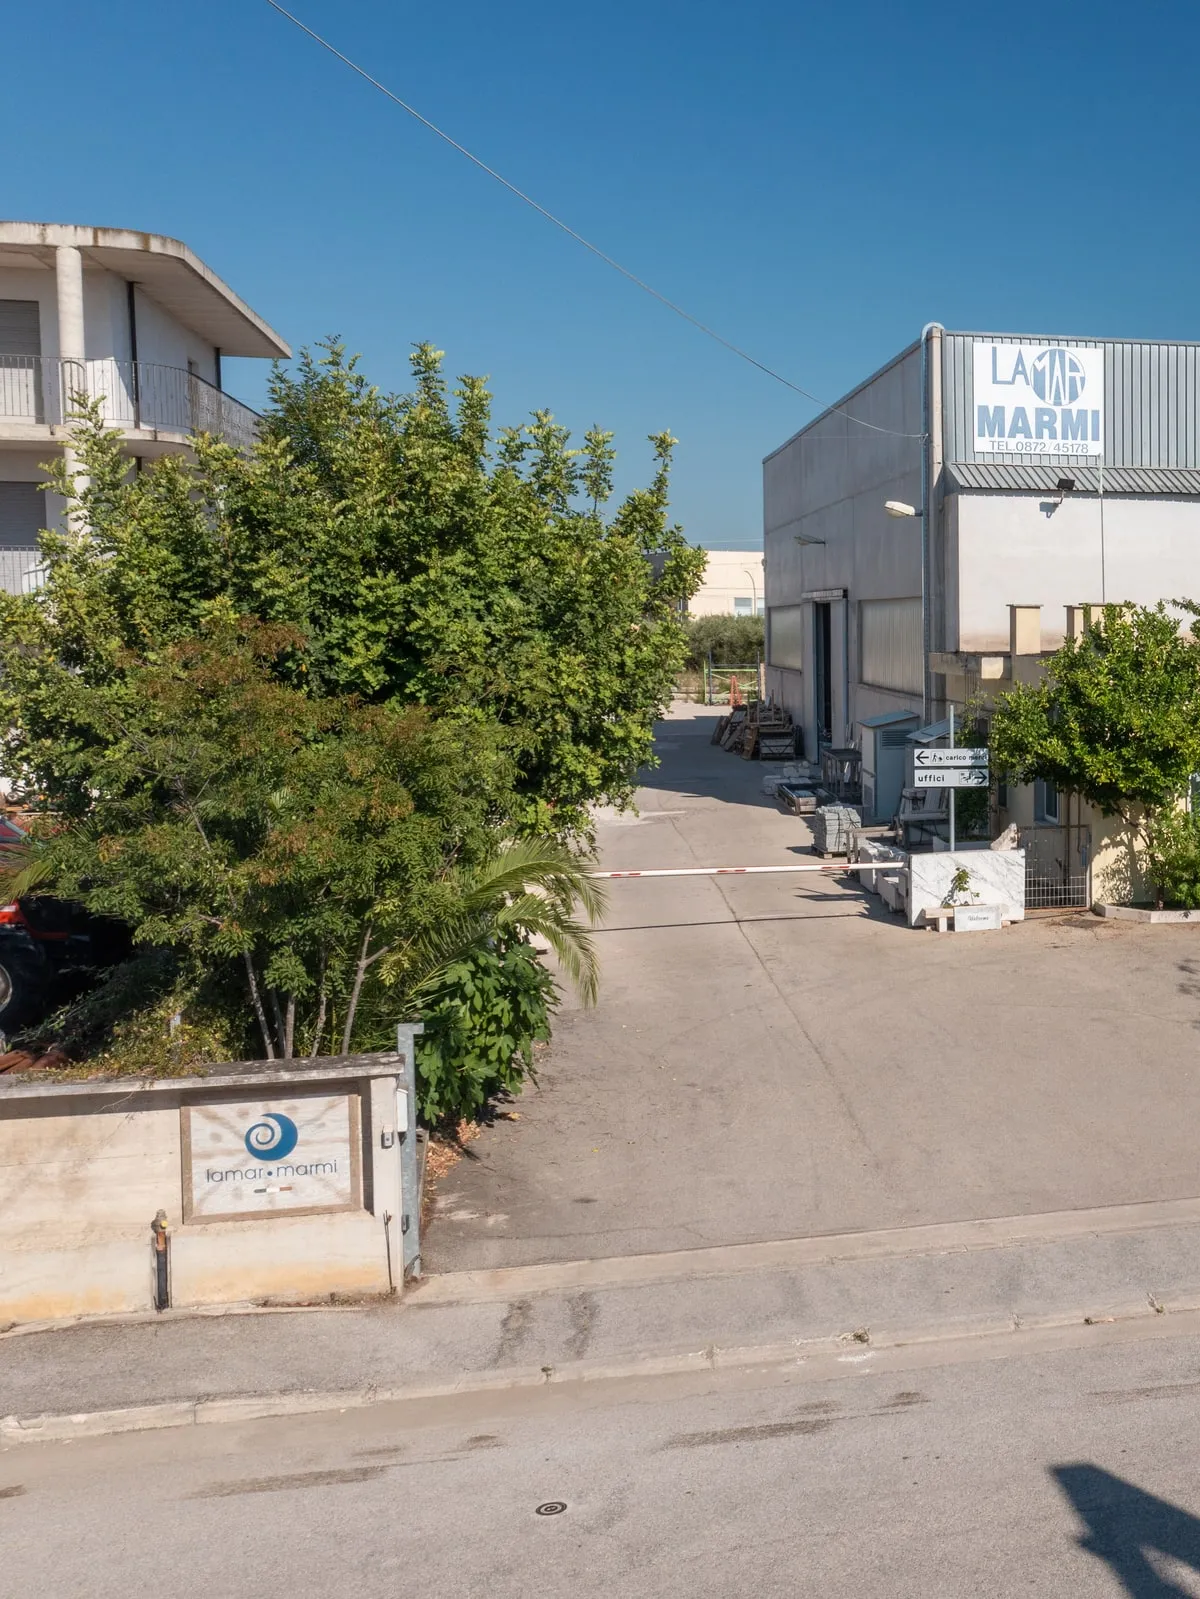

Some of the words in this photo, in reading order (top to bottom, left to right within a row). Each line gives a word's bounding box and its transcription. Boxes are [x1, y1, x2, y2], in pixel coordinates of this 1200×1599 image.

[977, 405, 1100, 441] MARMI
[918, 774, 945, 782] uffici
[206, 1167, 264, 1183] lamar
[276, 1160, 337, 1177] marmi
